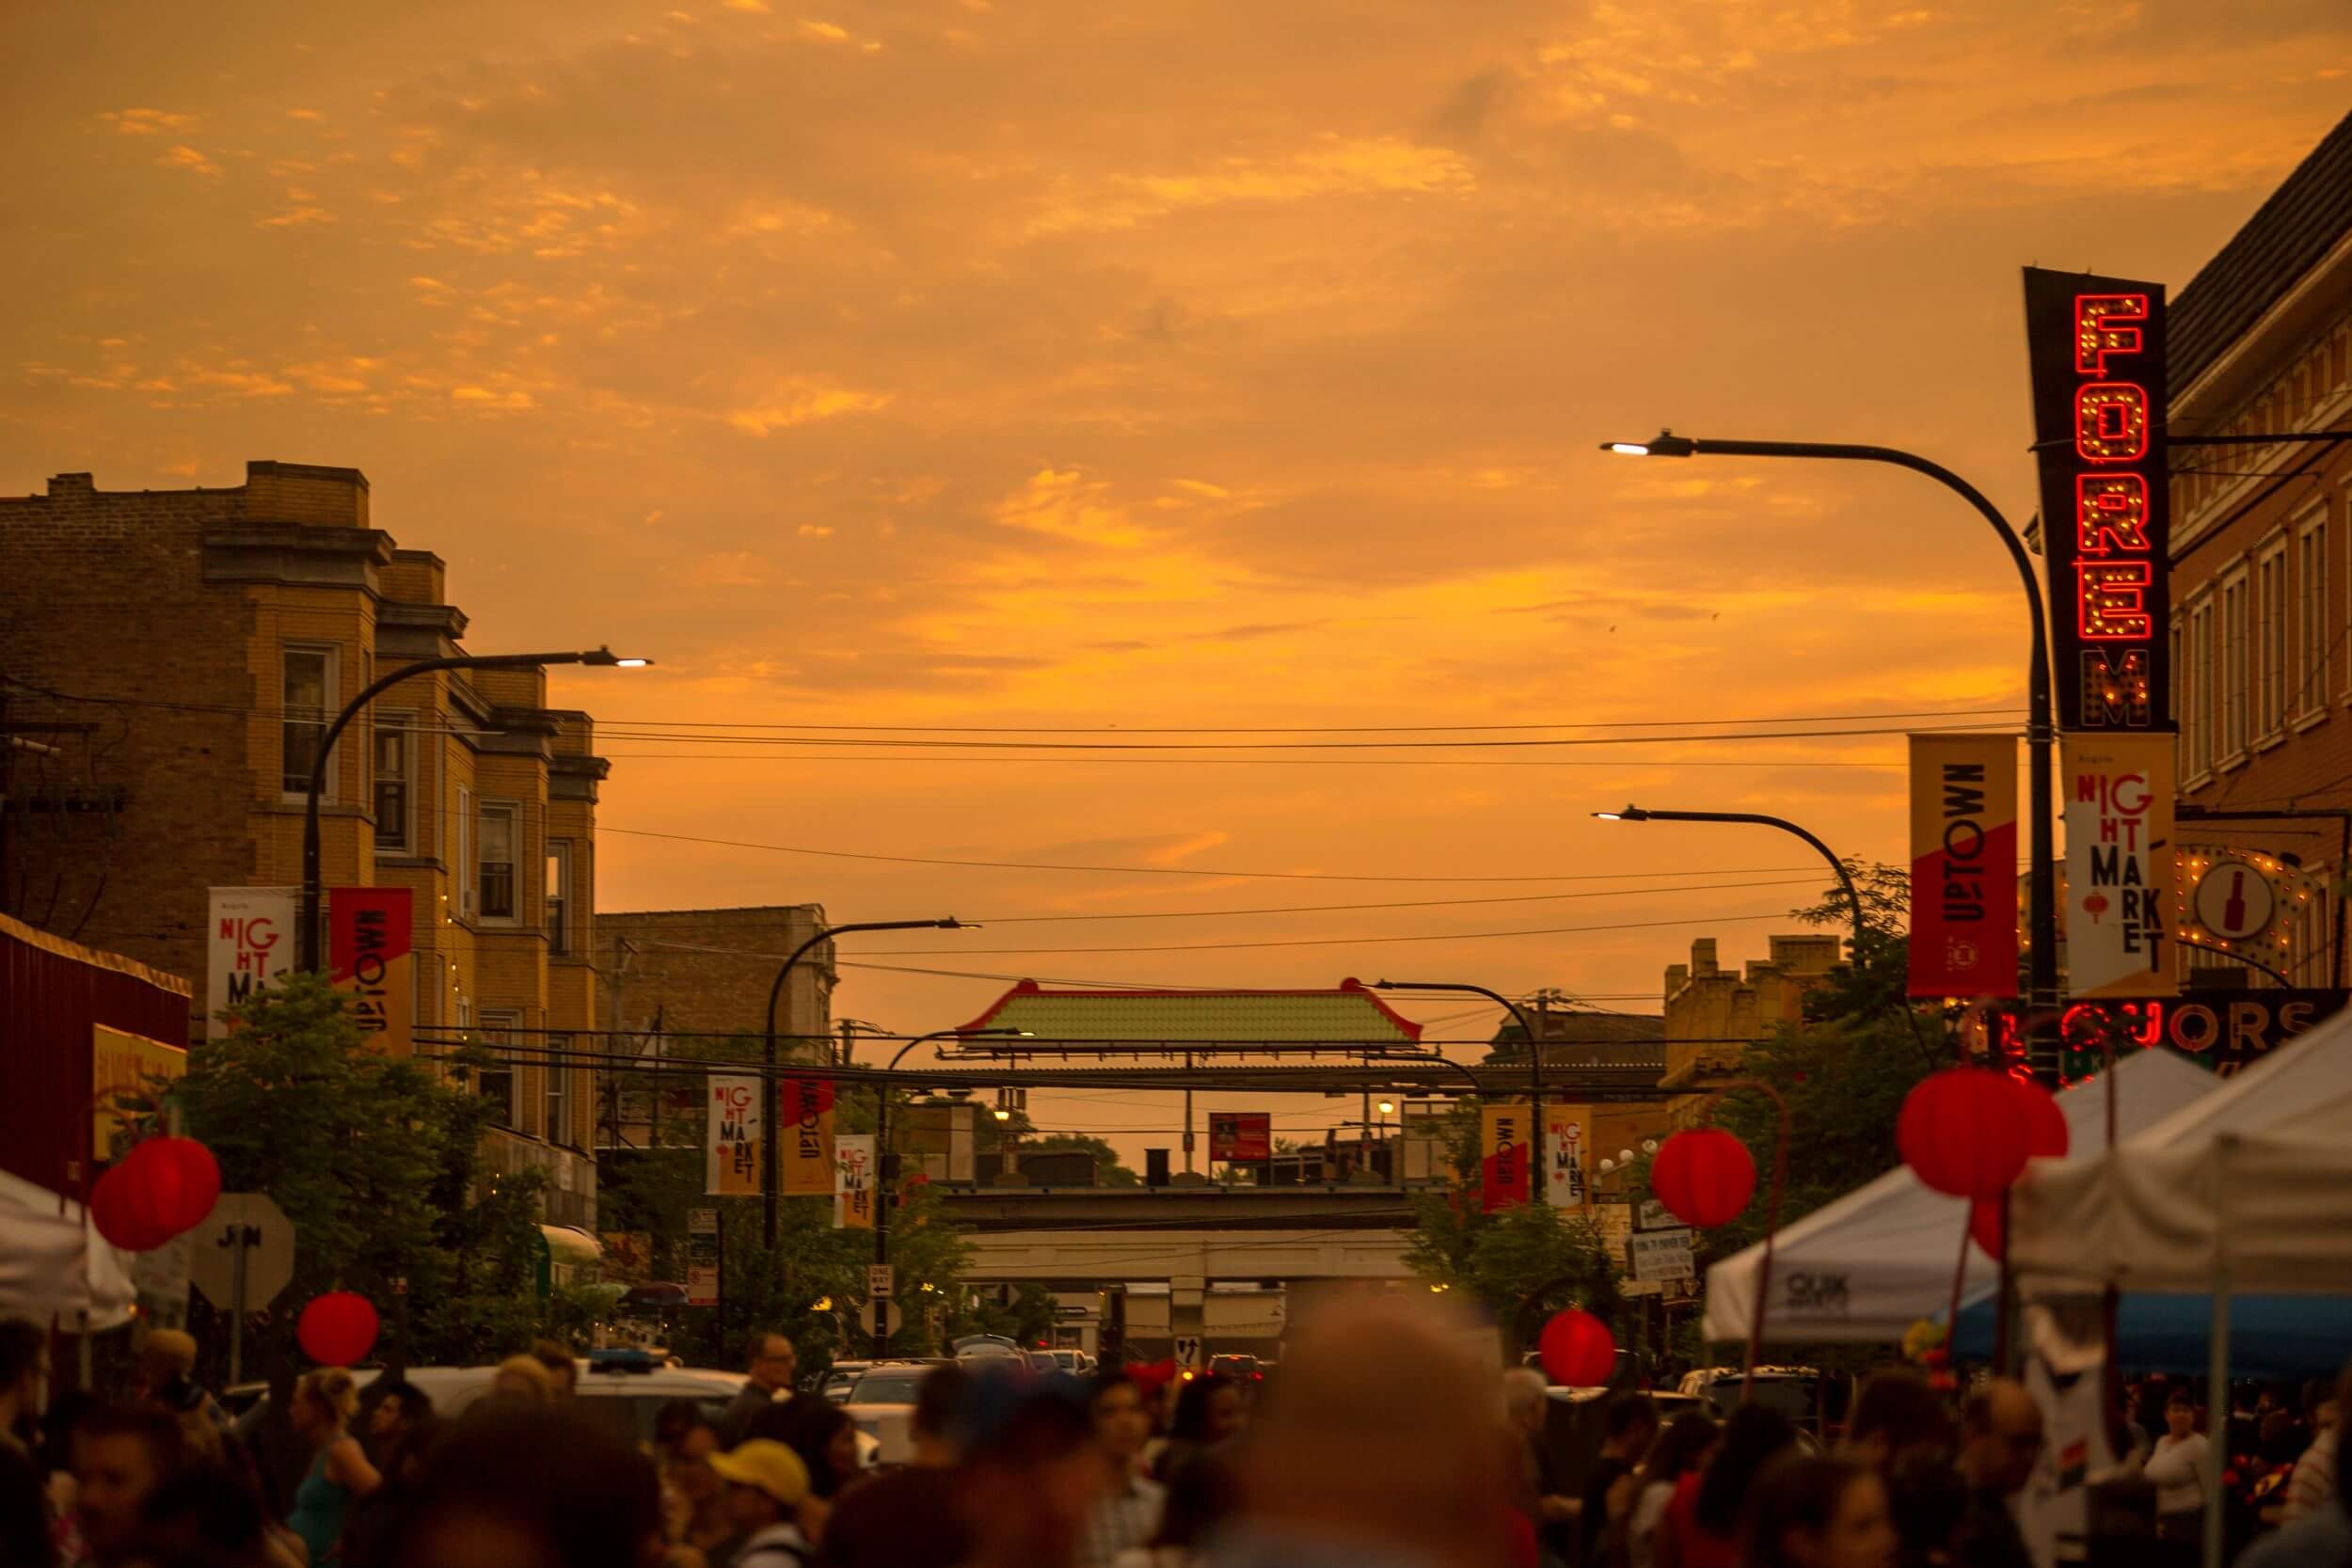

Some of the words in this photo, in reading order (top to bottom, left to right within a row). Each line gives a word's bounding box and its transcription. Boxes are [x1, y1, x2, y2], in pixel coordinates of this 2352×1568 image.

[2075, 294, 2151, 726] FOREM
[1943, 764, 1985, 922] UPTOWN
[1496, 1117, 1514, 1184] UPTOWN
